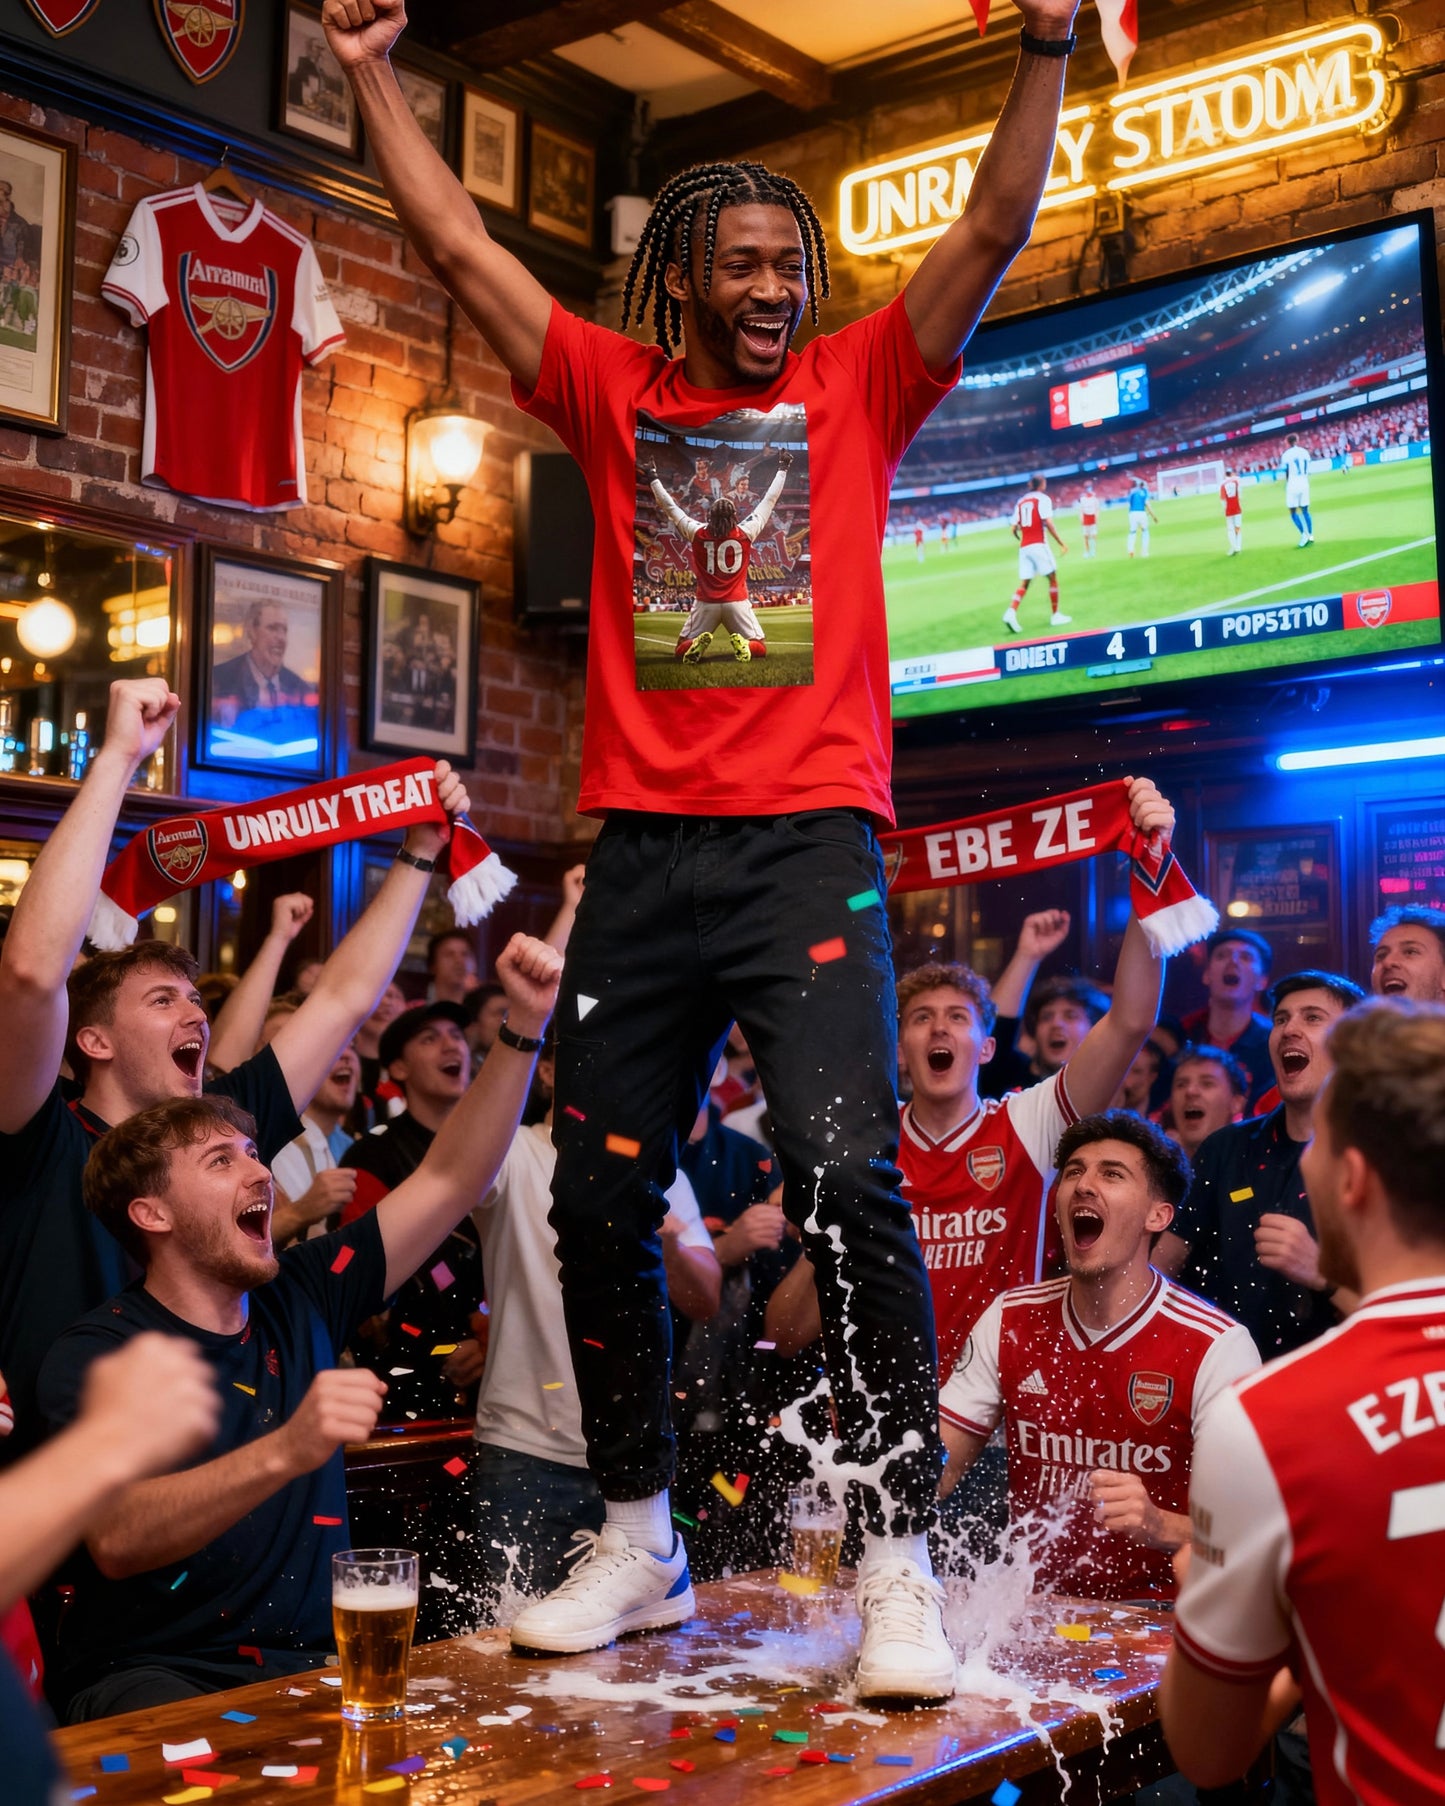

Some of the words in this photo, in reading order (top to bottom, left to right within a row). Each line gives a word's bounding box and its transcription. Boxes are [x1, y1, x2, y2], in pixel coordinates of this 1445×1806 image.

[702, 539, 744, 576] 10
[1105, 631, 1126, 660] 4
[1143, 626, 1158, 655] 1
[1189, 618, 1203, 648] 1
[223, 793, 340, 850] UNRULY
[342, 770, 434, 822] TREAT
[924, 819, 1018, 879] EBE
[1031, 798, 1096, 860] ZE
[1016, 1419, 1172, 1473] Emirates
